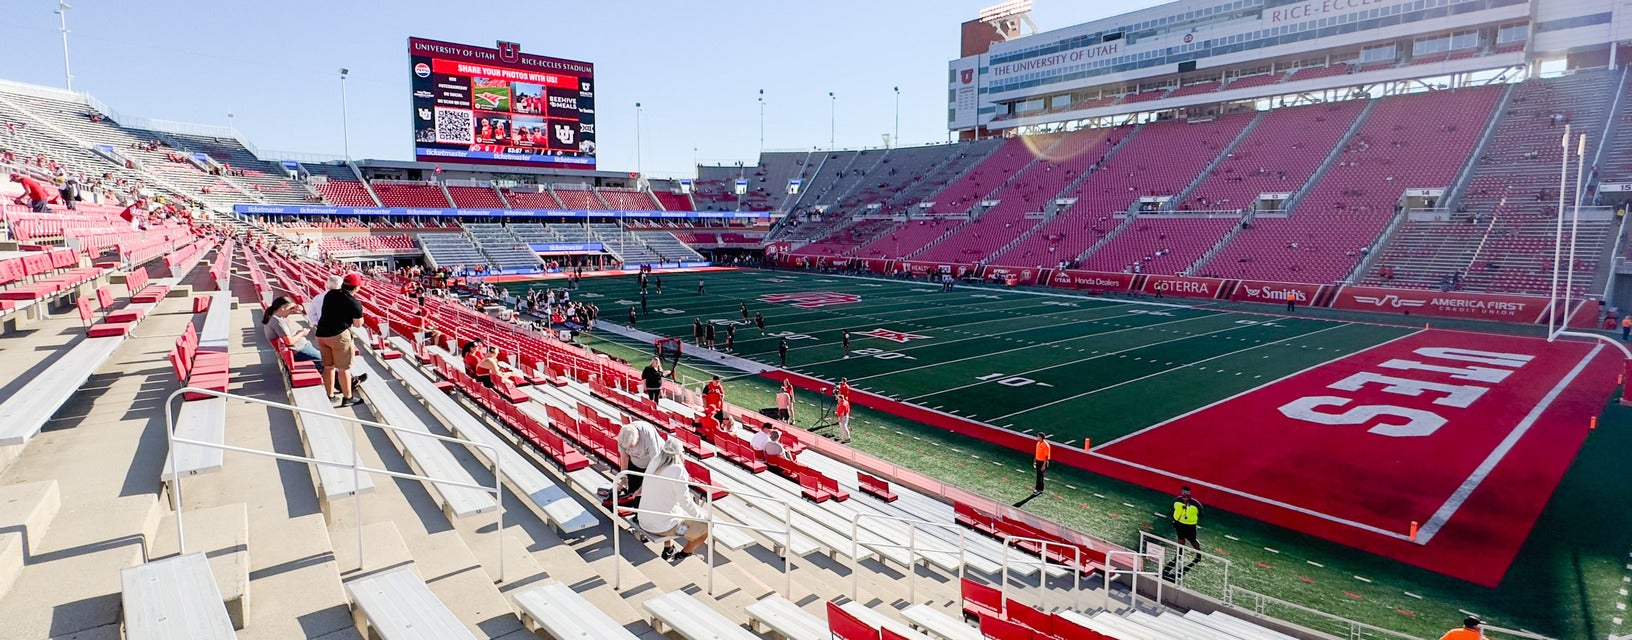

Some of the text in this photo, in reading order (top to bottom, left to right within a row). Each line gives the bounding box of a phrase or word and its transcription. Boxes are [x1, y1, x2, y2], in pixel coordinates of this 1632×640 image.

[415, 43, 461, 55] UNIVERSITY
[475, 51, 495, 60] UTAH
[522, 58, 592, 73] RICE-ECCLES STADIUM
[994, 43, 1118, 76] THE UNIVERSITY OF UTAH
[458, 64, 558, 84] SHARE YOUR PHOTOS WITH US!
[550, 96, 576, 104] BEEHIVE
[426, 149, 468, 158] ticketmaster
[494, 153, 531, 161] ticketmaster
[248, 206, 284, 214] ticketmaster
[406, 208, 443, 216] ticketmaster
[1074, 276, 1095, 285] Honda
[1096, 278, 1120, 287] Dealers
[1430, 298, 1526, 310] AMERICA FIRST
[850, 348, 906, 360] 20
[975, 373, 1036, 386] 10
[1277, 347, 1536, 438] UTES
